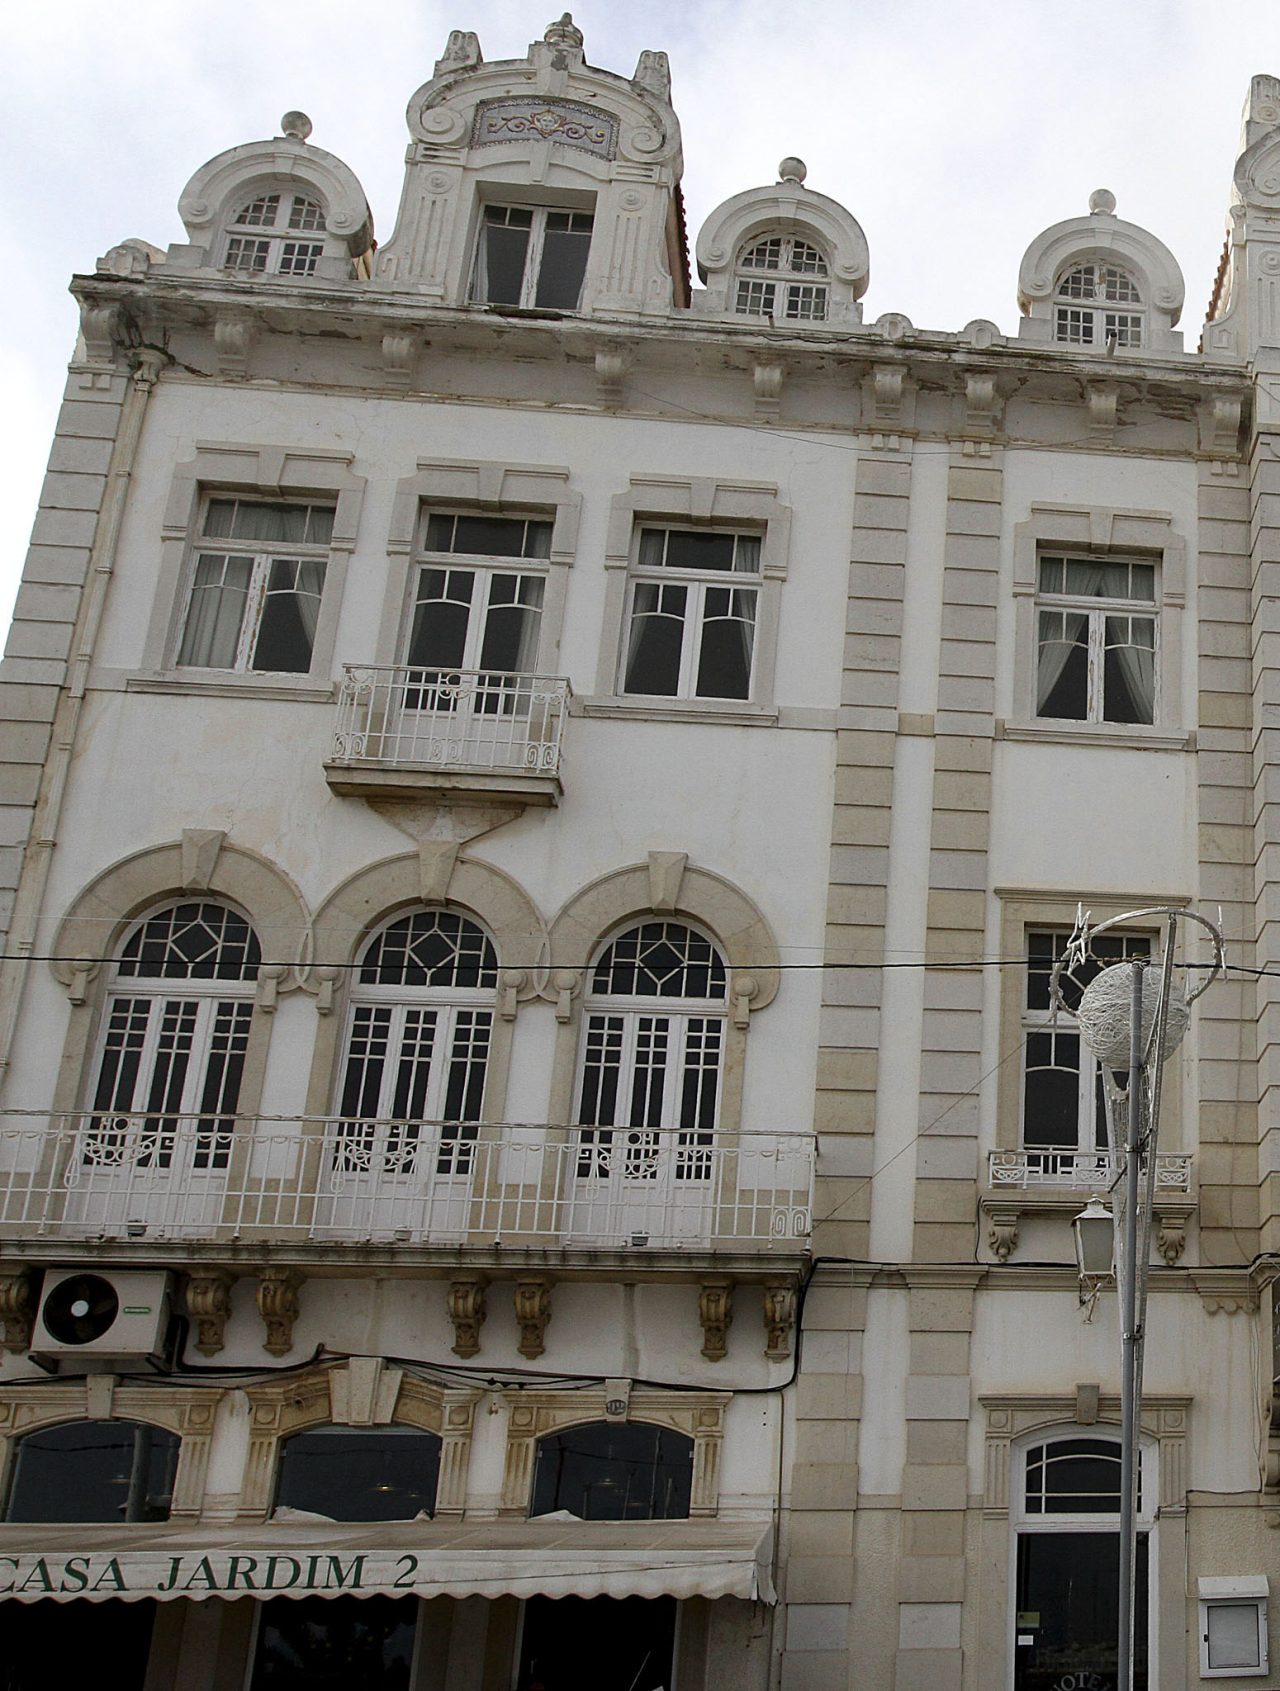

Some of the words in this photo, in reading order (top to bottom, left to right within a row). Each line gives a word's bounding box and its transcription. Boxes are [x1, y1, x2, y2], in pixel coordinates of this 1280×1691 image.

[0, 1556, 130, 1594] CASA
[157, 1554, 369, 1592] JARDIM
[393, 1554, 419, 1589] 2
